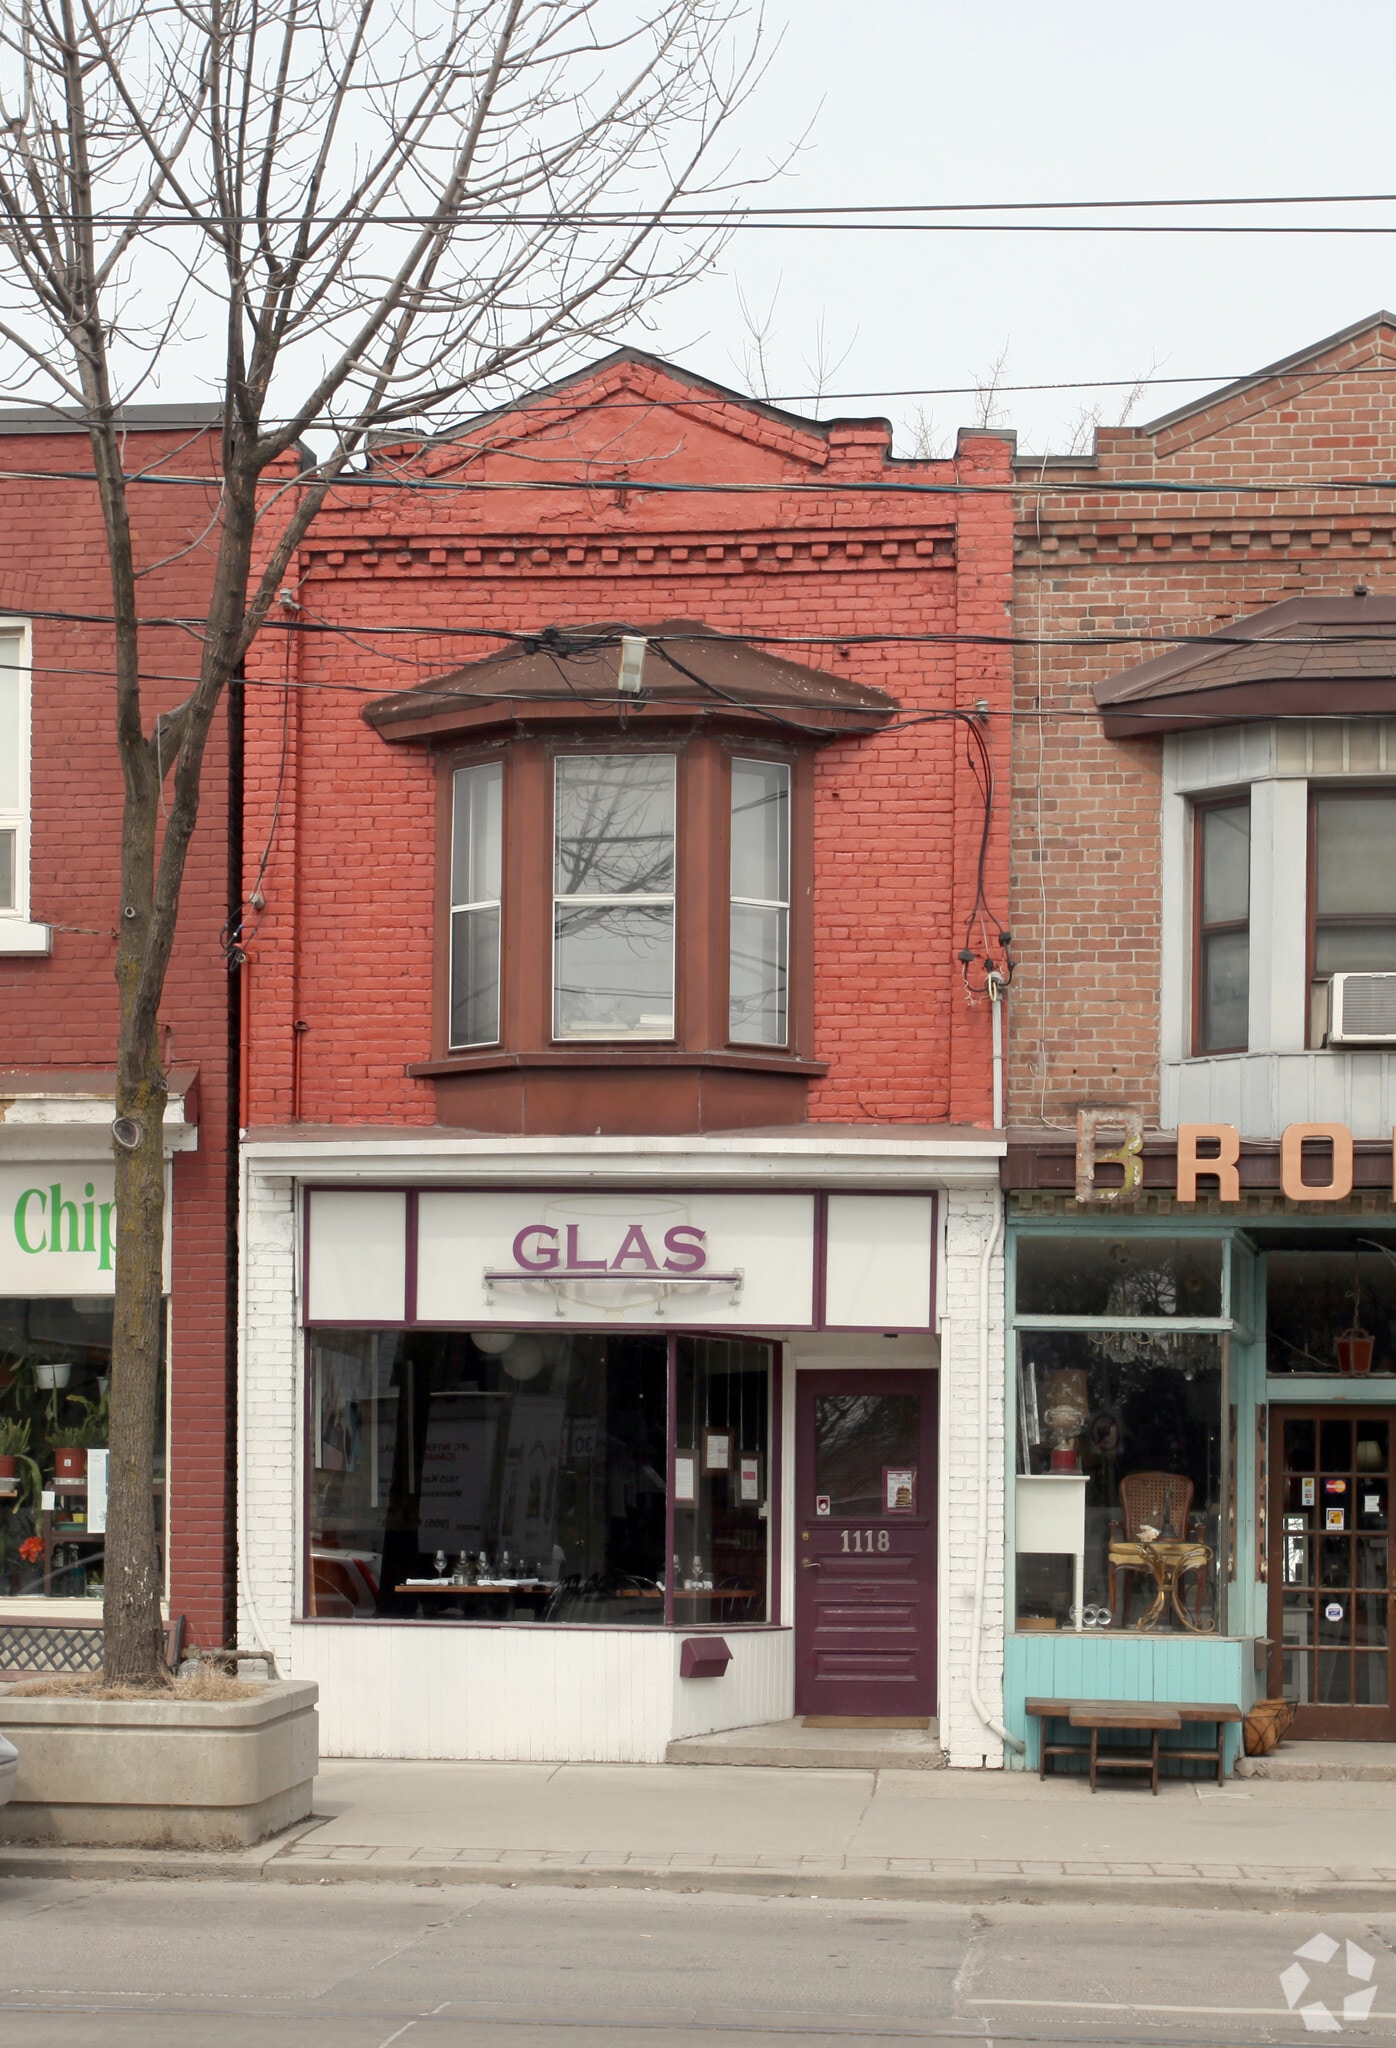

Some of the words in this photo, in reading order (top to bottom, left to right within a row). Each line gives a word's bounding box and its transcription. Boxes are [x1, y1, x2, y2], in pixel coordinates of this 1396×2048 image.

[1076, 1108, 1396, 1203] BRO
[512, 1224, 707, 1272] GLAS
[840, 1530, 890, 1552] 1118
